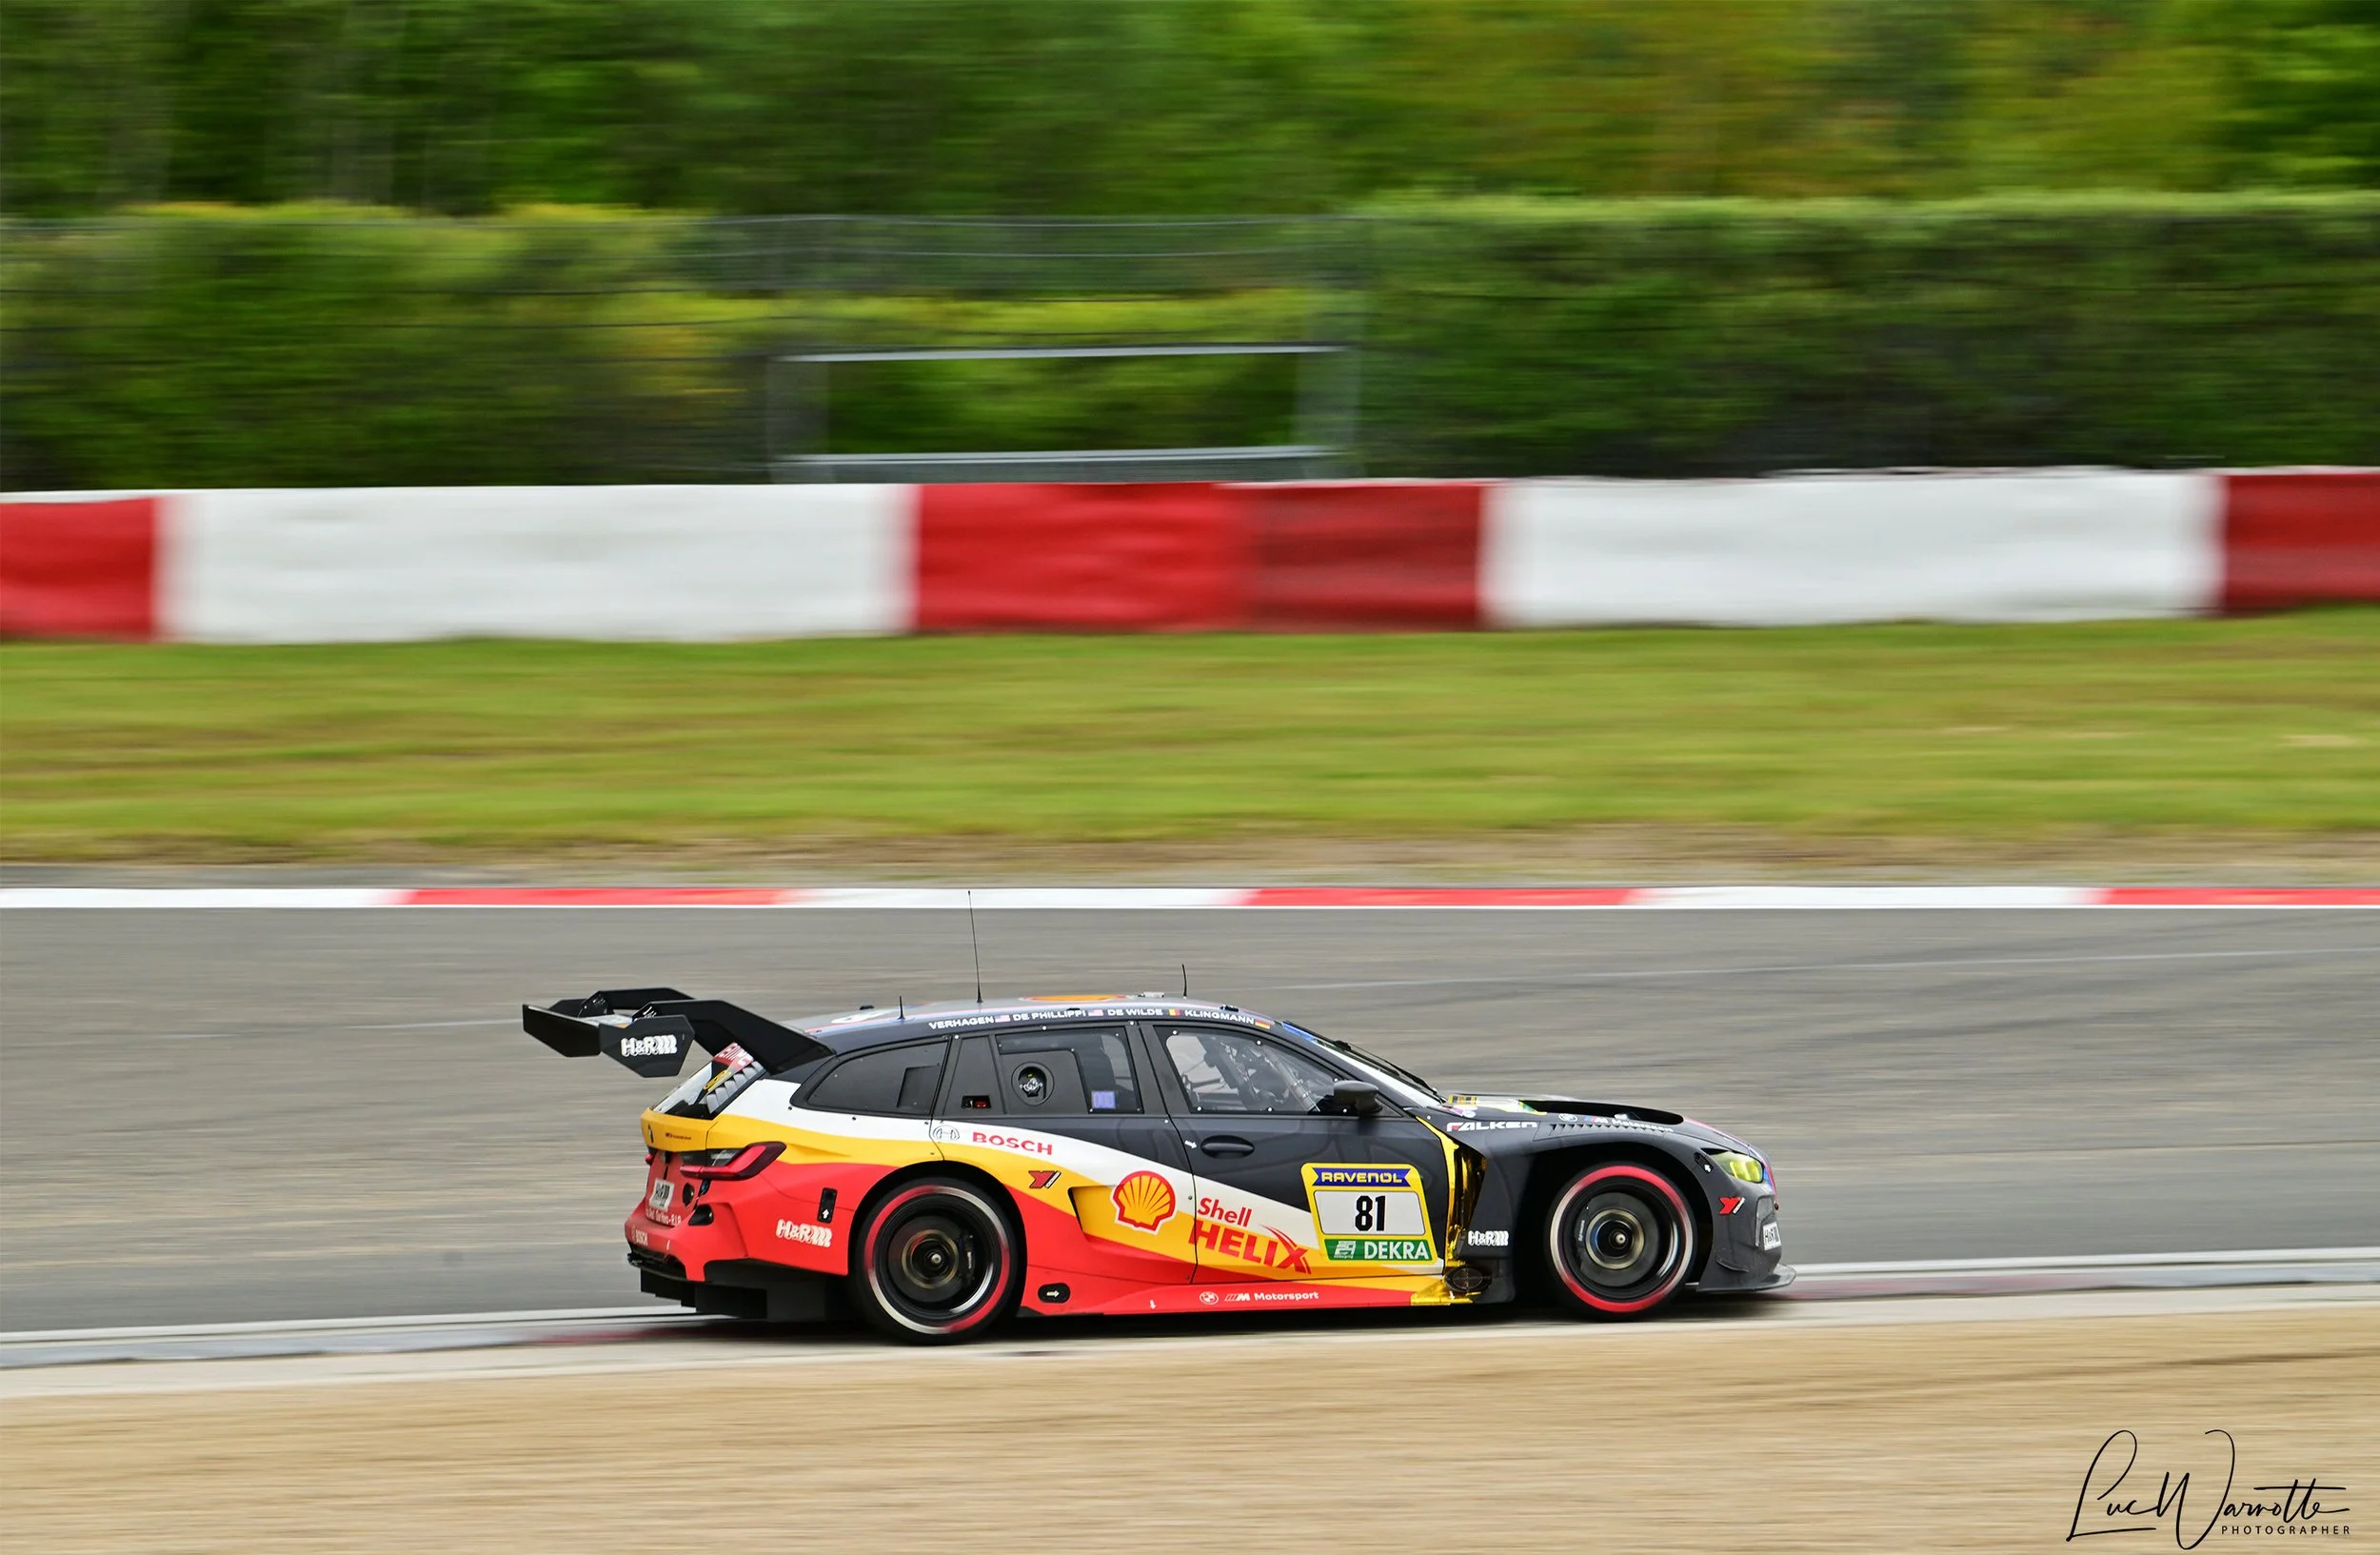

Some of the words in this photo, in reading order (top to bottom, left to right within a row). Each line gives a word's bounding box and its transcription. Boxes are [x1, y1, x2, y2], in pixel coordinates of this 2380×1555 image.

[928, 1015, 994, 1030] VERHAGEN
[1013, 1013, 1029, 1022] DE
[1031, 1009, 1086, 1020] PHILLIPPI
[1107, 1008, 1124, 1017] DE
[1185, 1010, 1255, 1025] KLINGMANN
[1446, 1121, 1538, 1132] FALKEN
[971, 1131, 1053, 1156] BOSCH
[1320, 1171, 1403, 1184] RAVENOL
[1198, 1197, 1253, 1226] Shell
[1355, 1195, 1386, 1231] 81
[1187, 1221, 1312, 1275] HELIX
[1364, 1240, 1430, 1260] DEKRA
[1253, 1291, 1319, 1301] Motorsport
